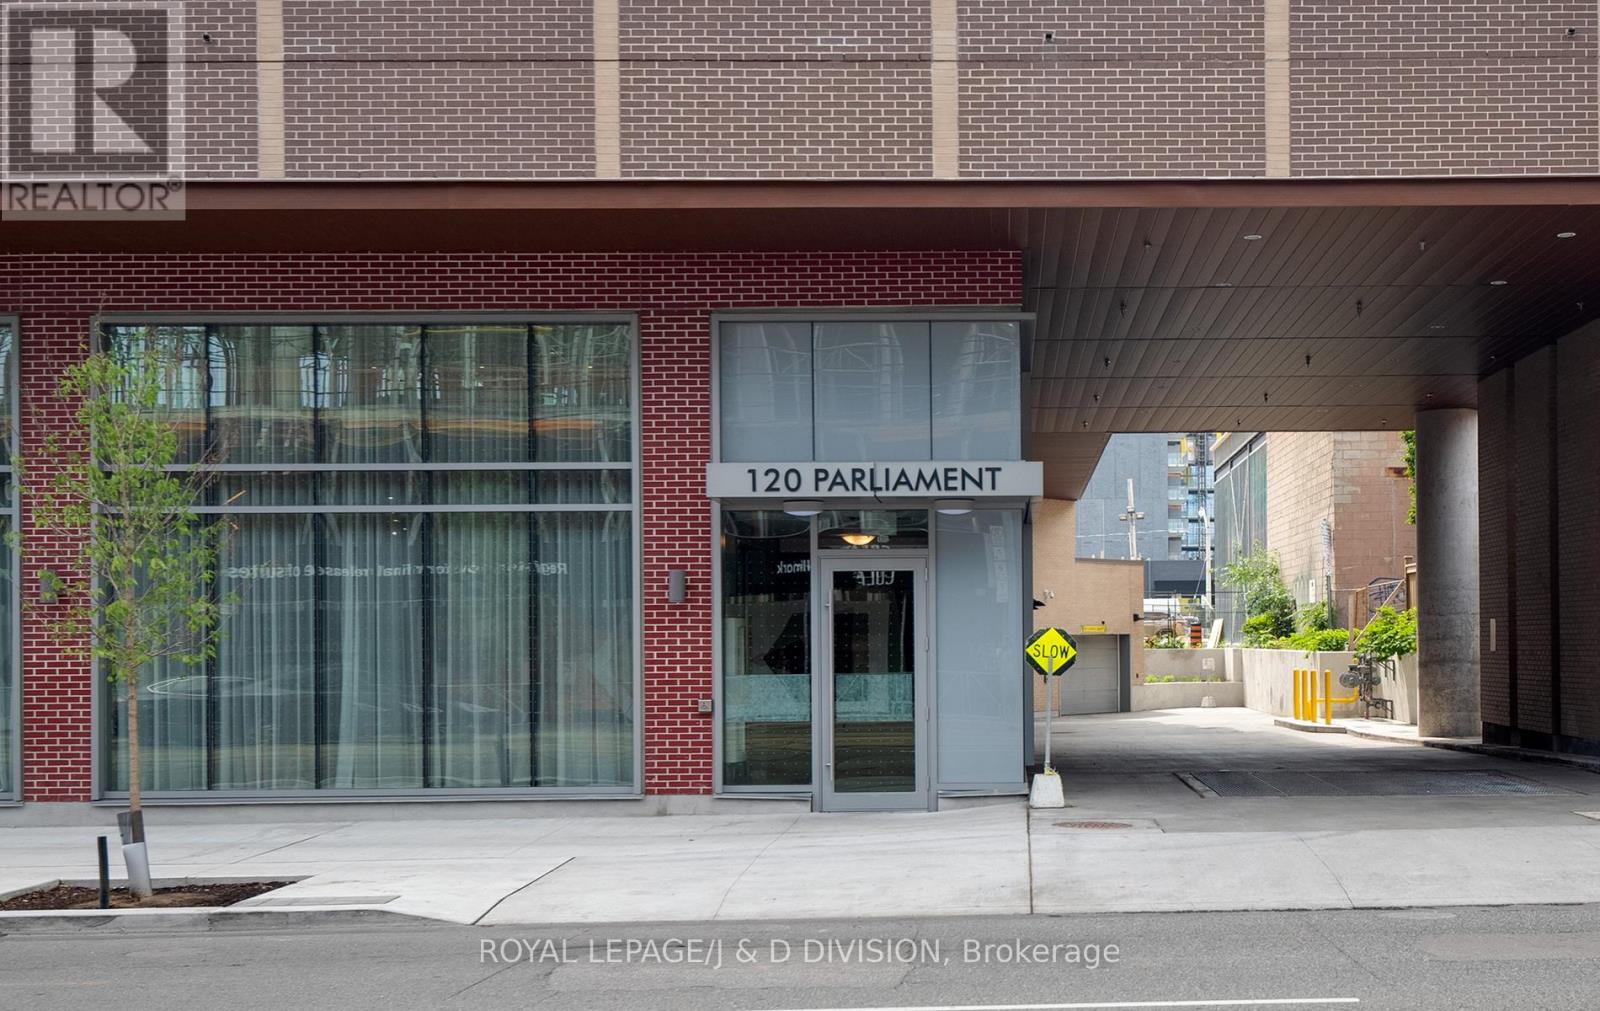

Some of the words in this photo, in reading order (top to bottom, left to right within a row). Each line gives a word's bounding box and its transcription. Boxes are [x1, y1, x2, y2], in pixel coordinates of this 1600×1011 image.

[747, 468, 802, 493] 120
[813, 467, 1002, 493] PARLIAMENT
[1033, 644, 1070, 659] SLOW
